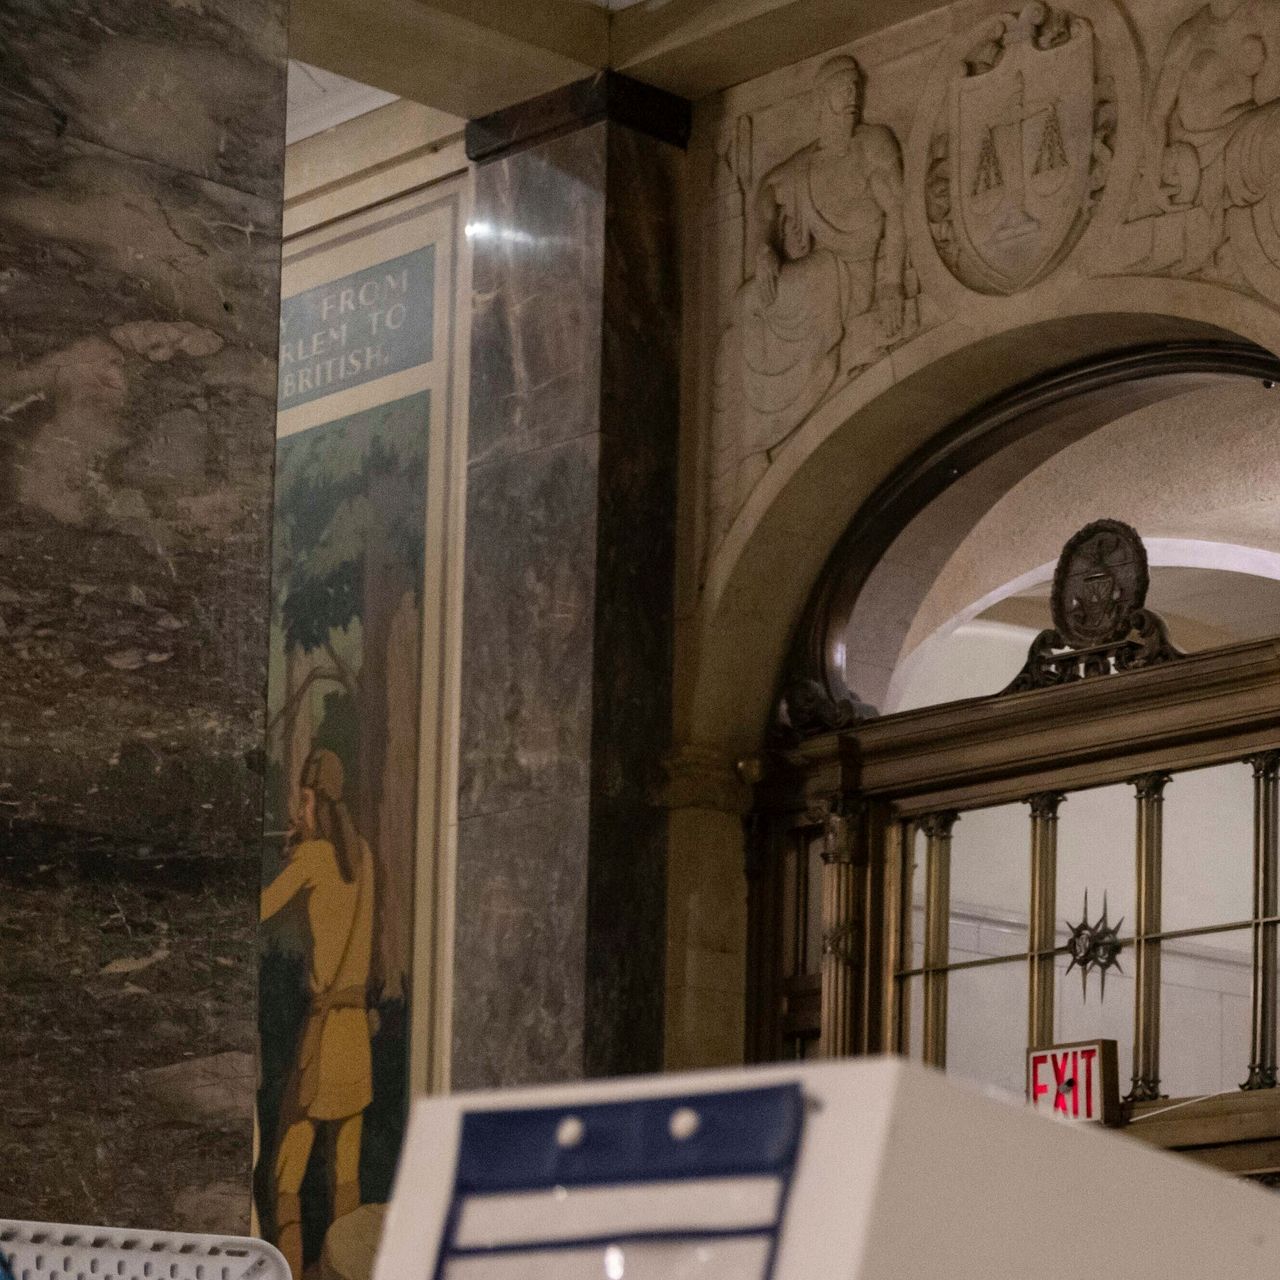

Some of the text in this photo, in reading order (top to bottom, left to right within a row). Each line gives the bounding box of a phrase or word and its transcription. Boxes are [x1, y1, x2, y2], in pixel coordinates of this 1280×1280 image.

[322, 269, 408, 321] FROM
[369, 304, 407, 335] TO
[1032, 1048, 1097, 1119] EXIT
